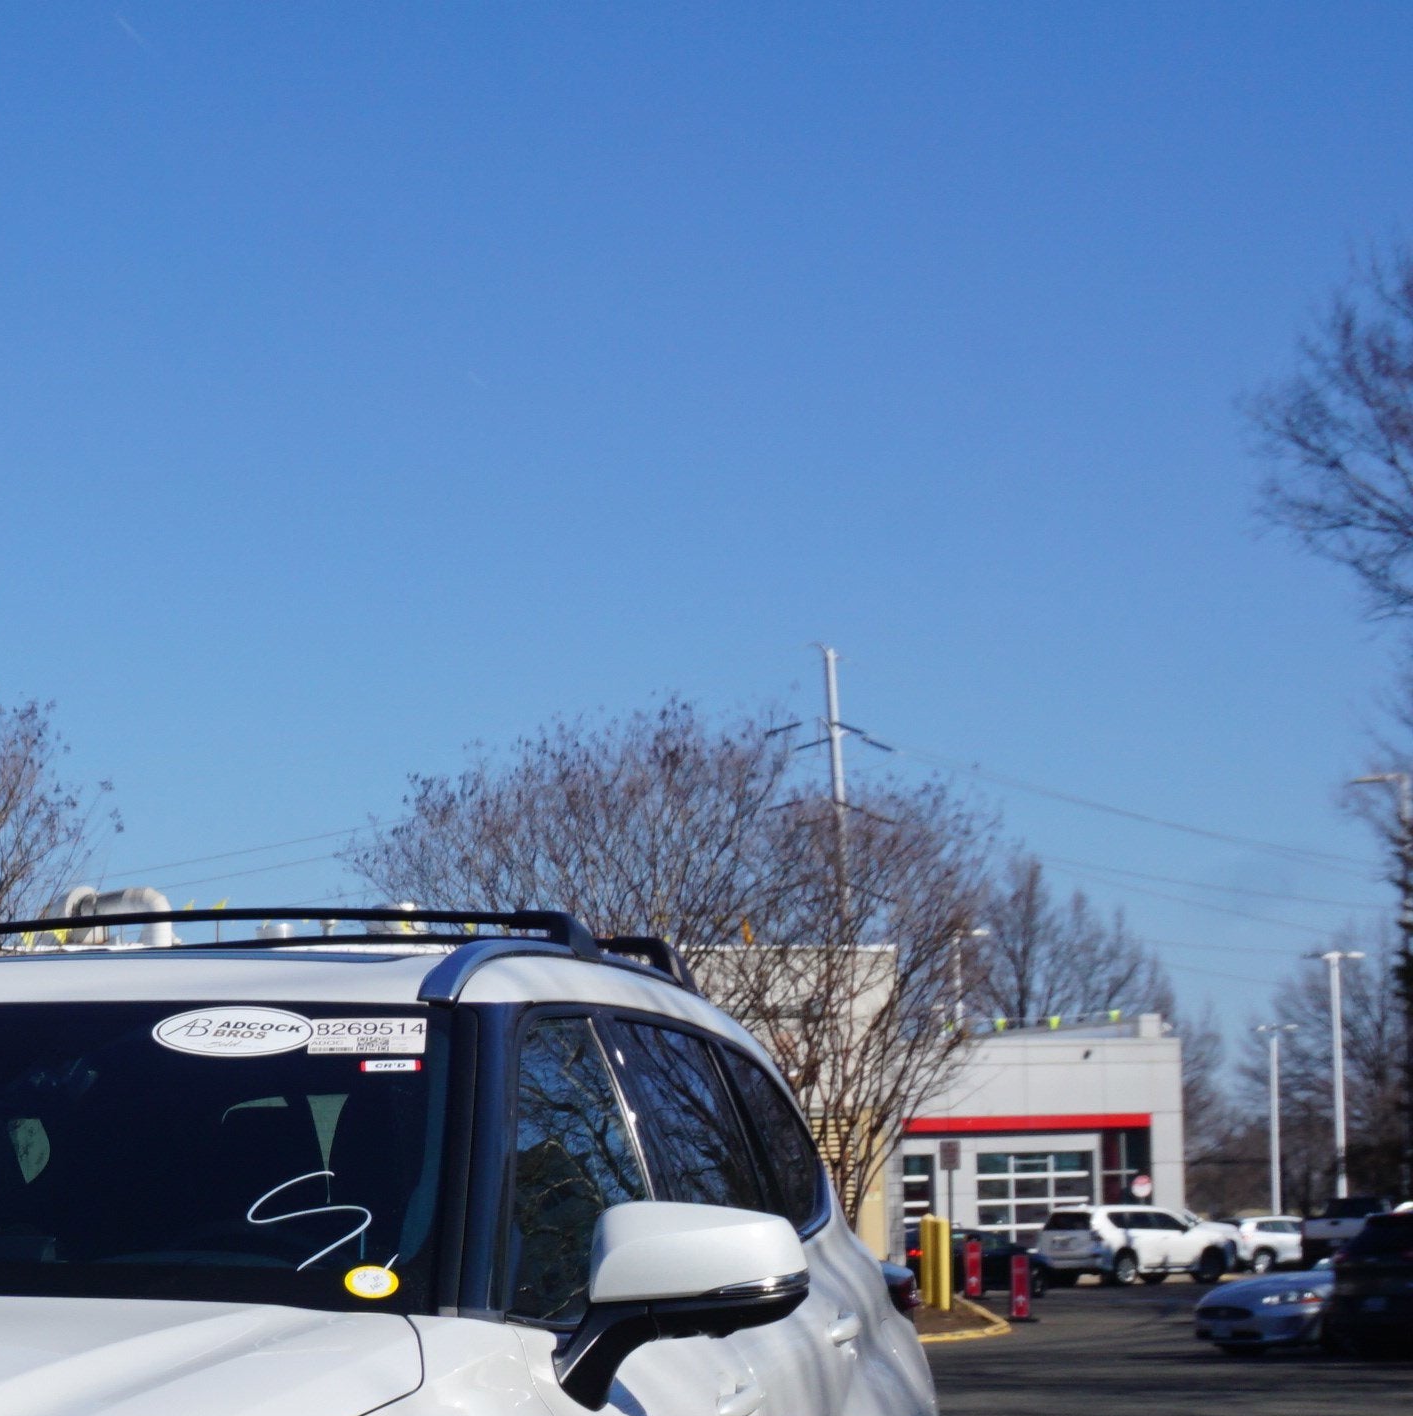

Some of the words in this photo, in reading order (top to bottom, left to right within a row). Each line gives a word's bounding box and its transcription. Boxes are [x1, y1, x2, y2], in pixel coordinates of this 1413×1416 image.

[218, 1020, 302, 1033] ADCOCK
[316, 1022, 427, 1036] 8269514
[212, 1029, 268, 1040] BROS
